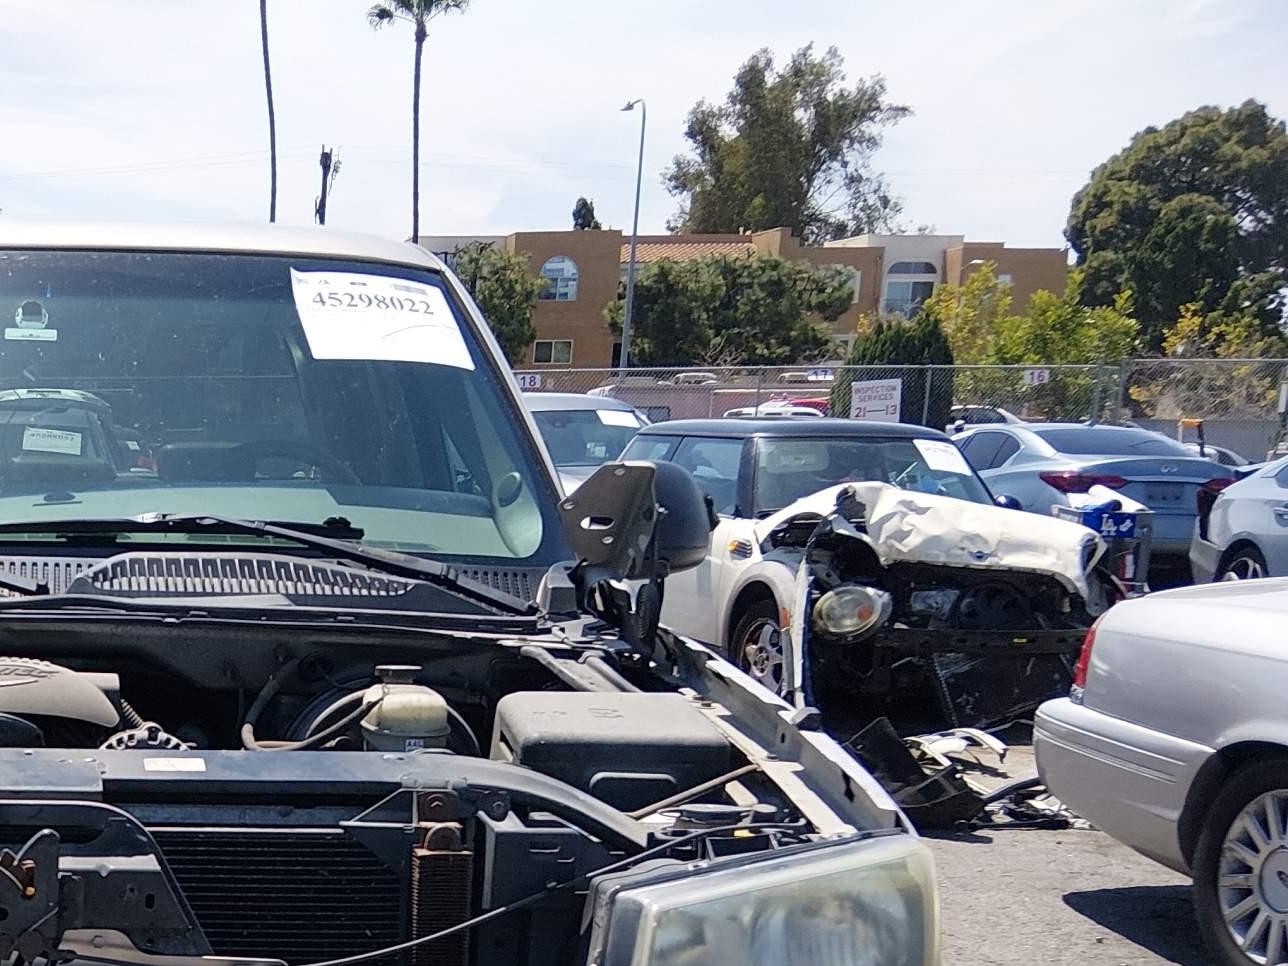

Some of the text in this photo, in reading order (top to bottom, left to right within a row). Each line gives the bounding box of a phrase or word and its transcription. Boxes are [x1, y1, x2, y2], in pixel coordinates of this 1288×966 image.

[312, 290, 434, 315] 45298022
[519, 375, 537, 387] 18
[1029, 370, 1046, 382] 16
[854, 384, 897, 395] INSPECTION
[857, 393, 894, 403] SERVICES
